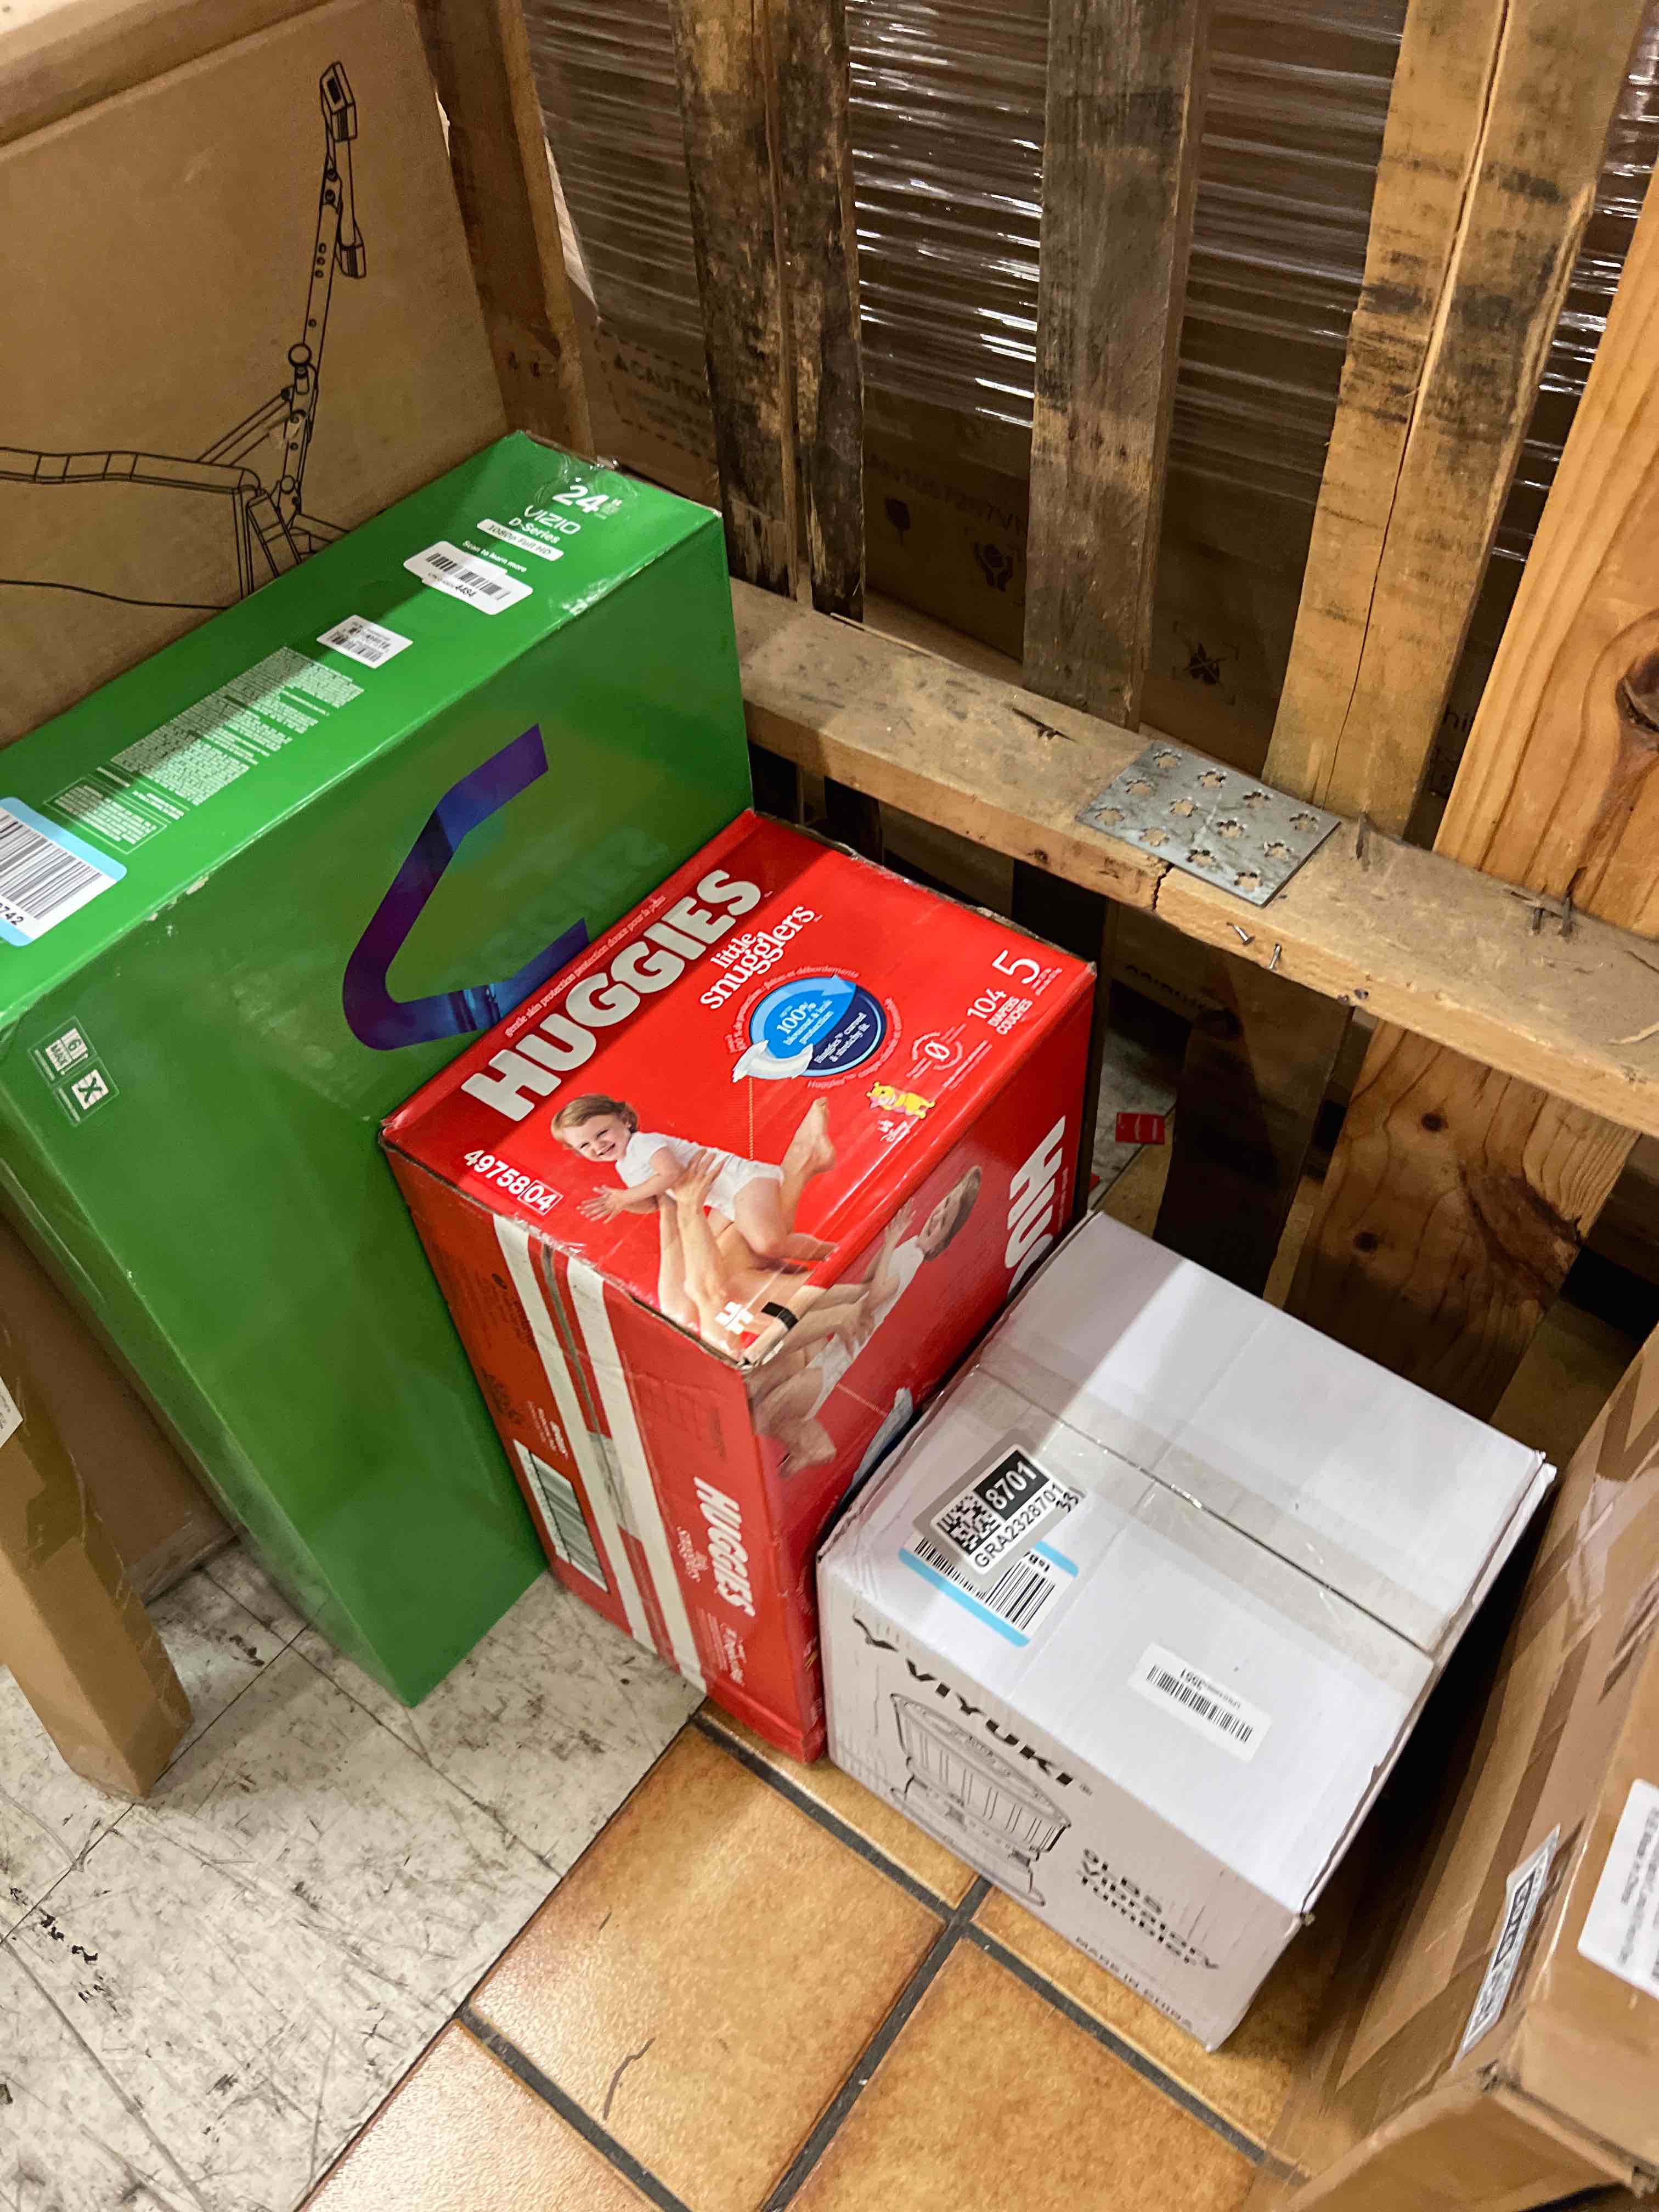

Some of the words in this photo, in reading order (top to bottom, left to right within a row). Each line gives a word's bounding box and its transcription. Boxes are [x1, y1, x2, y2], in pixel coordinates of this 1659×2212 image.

[509, 518, 560, 544] D-Series
[524, 505, 581, 535] VIZIO
[462, 540, 481, 554] Scan
[481, 548, 490, 556] to
[489, 551, 509, 566] learn
[508, 560, 527, 573] more
[488, 524, 517, 541] 1080p
[517, 538, 536, 551] Full
[534, 545, 551, 555] HD
[699, 905, 816, 1009] snugglers
[710, 932, 757, 967] little
[992, 950, 1040, 984] 5
[461, 870, 761, 1121] HUGGIES
[526, 1000, 543, 1017] skin
[540, 974, 575, 1006] protection
[574, 943, 608, 977] protection
[777, 1001, 817, 1034] 100%
[966, 986, 1008, 1019] 104
[987, 997, 1015, 1028] DIAPERS
[995, 998, 1032, 1036] COUCHES
[985, 1460, 1037, 1510] 8701
[974, 1482, 1064, 1568] GRA2328701
[693, 1476, 755, 1617] HUGGIES
[905, 1658, 1074, 1786] VIYUKI
